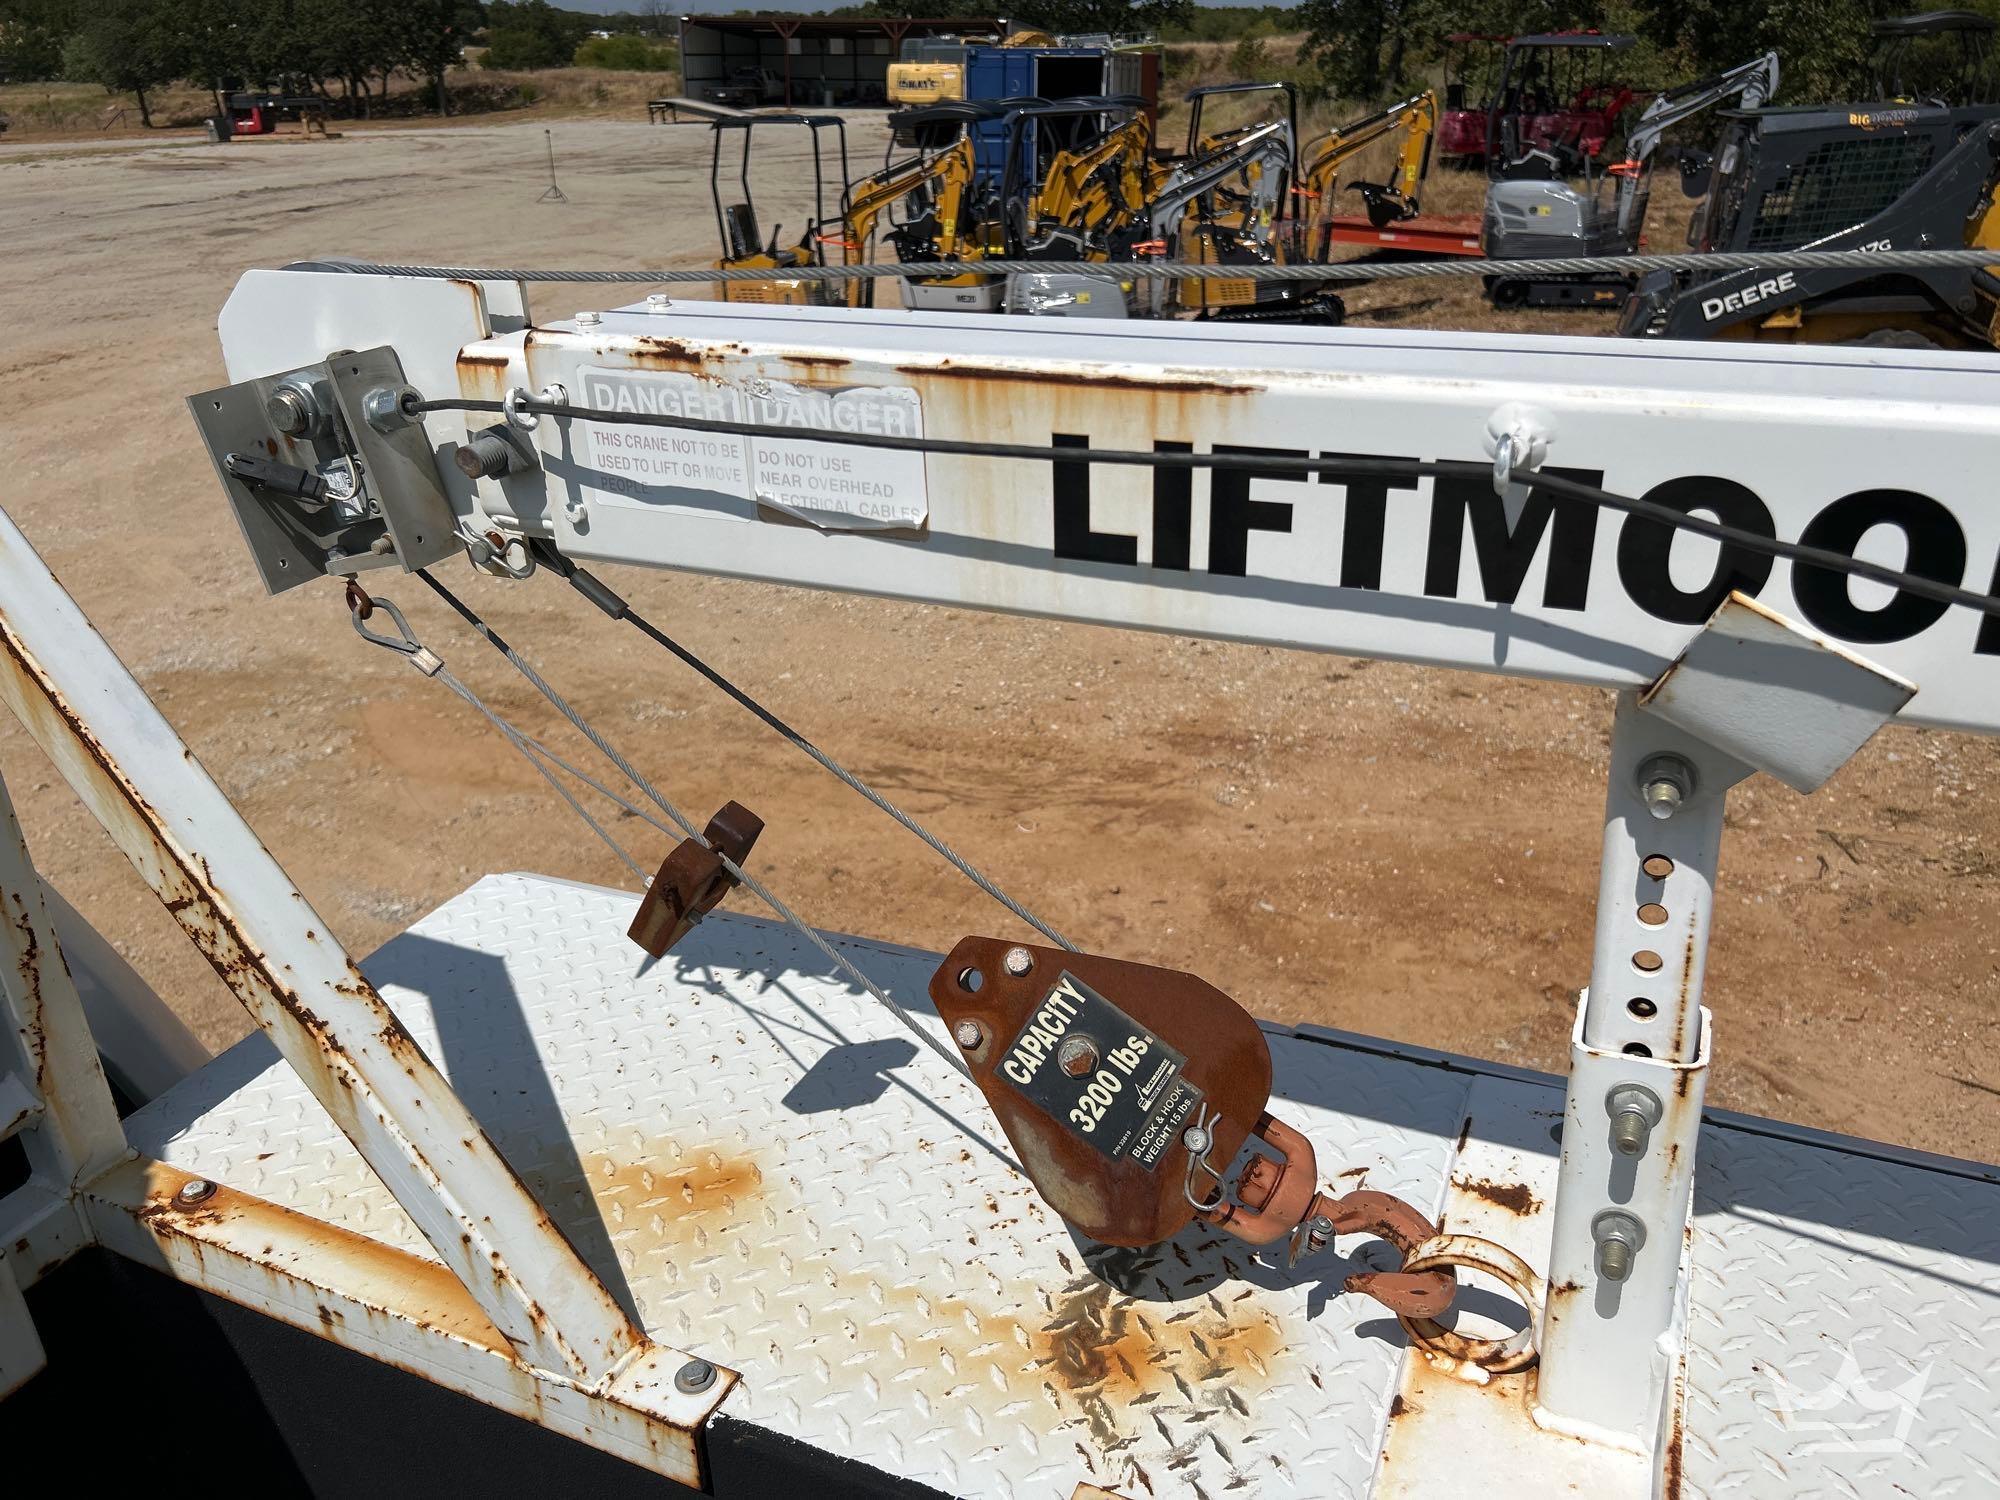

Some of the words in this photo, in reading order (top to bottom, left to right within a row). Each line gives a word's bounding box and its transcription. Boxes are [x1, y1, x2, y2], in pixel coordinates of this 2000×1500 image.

[1849, 112, 1870, 126] BIG
[1701, 271, 1797, 321] DEERE
[594, 383, 727, 421] DANGER
[760, 399, 907, 437] DANGER
[593, 431, 622, 448] THIS
[625, 434, 669, 452] CRANE
[672, 439, 698, 454] NOT
[700, 441, 717, 457] TO
[721, 443, 738, 459] BE
[759, 450, 780, 465] DO
[785, 453, 814, 470] NOT
[821, 457, 852, 473] USE
[597, 454, 630, 470] USED
[632, 458, 649, 473] TO
[653, 460, 679, 476] LIFT
[683, 463, 701, 479] OR
[705, 465, 741, 482] MOVE
[761, 471, 802, 488] NEAR
[808, 476, 894, 499] OVERHEAD
[1052, 433, 2000, 656] LIFTMOO
[1003, 977, 1087, 1085] CAPACITY
[1069, 1069, 1123, 1133] 3200
[1106, 1035, 1154, 1076] lbs.
[1132, 1123, 1159, 1158] BLOCK
[1155, 1116, 1165, 1124] &
[1160, 1085, 1184, 1116] HOOK
[1143, 1124, 1172, 1163] WEIGHT
[1170, 1112, 1181, 1125] 15
[1177, 1098, 1194, 1114] lbs.
